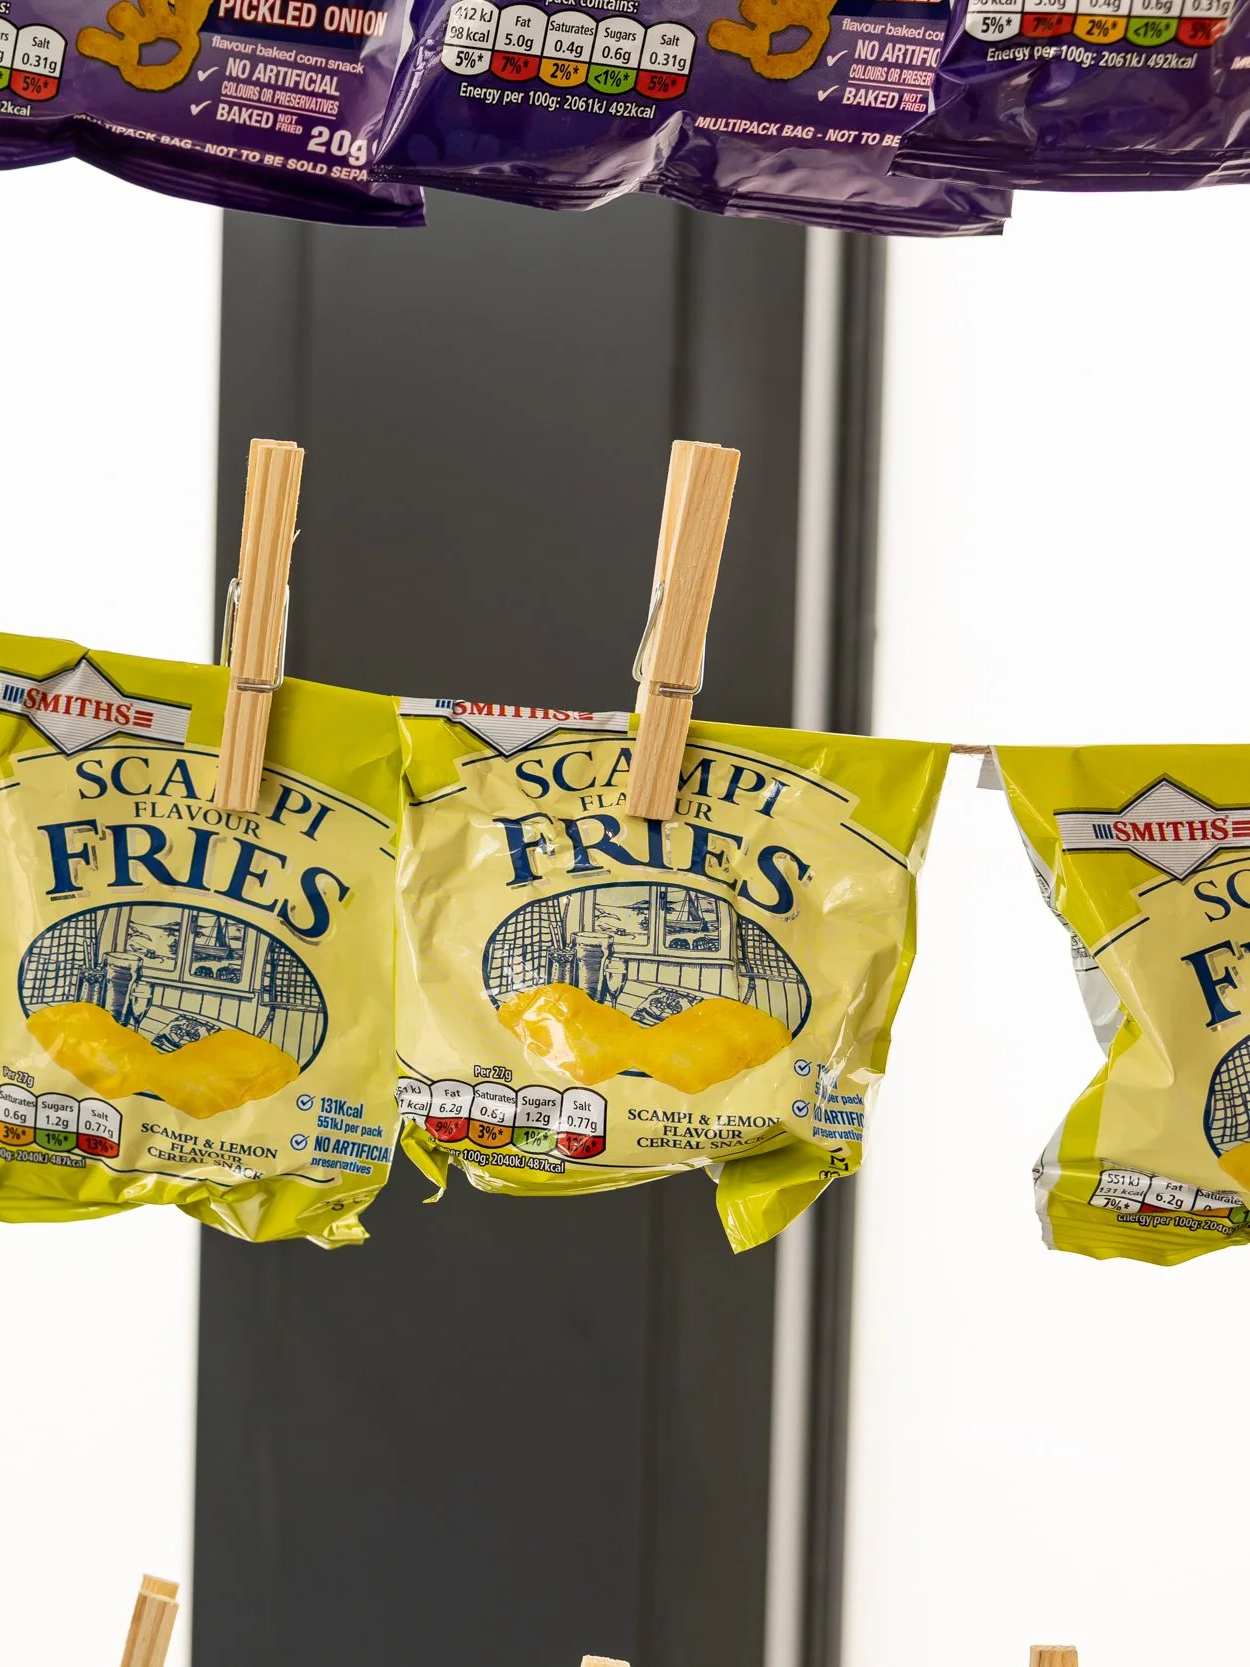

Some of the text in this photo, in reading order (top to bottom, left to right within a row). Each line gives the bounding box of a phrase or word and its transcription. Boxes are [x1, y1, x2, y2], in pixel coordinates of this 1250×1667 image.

[480, 9, 494, 23] kJ
[586, 0, 639, 14] contains:
[218, 0, 388, 37] PICKLED ONION
[515, 15, 531, 28] Fat
[450, 25, 491, 44] 98 kcal
[550, 20, 595, 37] Saturates
[604, 27, 637, 43] Sugars
[842, 19, 924, 39] flavour baked
[32, 36, 50, 50] Salt
[504, 33, 534, 51] 5.0g
[554, 39, 584, 58] 0.4g
[661, 34, 680, 47] Salt
[211, 35, 365, 75] flavour baked corn snack
[602, 46, 632, 64] 0.6g
[855, 39, 879, 61] NO
[987, 45, 1198, 70] Energy 100g: 2061kJ 492kcal
[21, 52, 58, 74] 0.31g
[649, 51, 687, 70] 0.31g
[225, 57, 340, 96] NO ARTIFICIAL
[849, 64, 900, 83] COLOURS OR
[221, 81, 339, 115] COLOURS OR PRESERVATIVES
[459, 82, 656, 120] Energy per 100g: 2061kJ 492kcal
[842, 88, 899, 110] BAKED
[903, 92, 924, 103] NOT
[216, 103, 274, 129] BAKED
[899, 101, 926, 114] FRIED
[277, 113, 299, 125] NOT
[275, 122, 303, 135] FRIED
[694, 116, 902, 148] MULTIPACK BAG NOT TO BE
[306, 125, 368, 167] 20g
[160, 135, 193, 150] BAG
[205, 143, 237, 159] NOT
[240, 148, 262, 163] TO
[263, 154, 284, 168] BE
[287, 157, 328, 176] SOLD
[23, 687, 131, 727] SMITHS
[76, 756, 336, 842] SCAPI
[580, 792, 714, 823] FLAUR
[134, 801, 263, 840] FLAVOUR
[1112, 817, 1229, 842] SMITHS
[492, 812, 813, 915] FRIES
[37, 819, 351, 940] FRIES
[3, 1066, 35, 1088] Per 27g
[474, 1066, 513, 1081] Per 27g
[0, 1090, 36, 1108] Saturates
[444, 1088, 461, 1098] Fat
[475, 1090, 516, 1105] Saturates
[41, 1101, 74, 1113] Sugars
[321, 1096, 364, 1119] 131Kcal
[439, 1103, 463, 1116] 6.2g
[522, 1096, 557, 1109] Sugars
[573, 1100, 592, 1112] Salt
[3, 1107, 28, 1124] 0.6g
[46, 1116, 70, 1130] 1.2g
[91, 1109, 109, 1122] Salt
[480, 1106, 505, 1123] 0.6g
[525, 1112, 551, 1126] 1.2g
[627, 1108, 781, 1128] SCAMPI & LEMON
[84, 1120, 114, 1138] 0.77g
[317, 1115, 383, 1138] 551kJ per pack
[567, 1115, 598, 1133] 0.77g
[662, 1126, 744, 1140] FLAVOUR
[141, 1122, 278, 1160] SCAMPI & LEMON
[314, 1135, 332, 1153] NO
[636, 1134, 767, 1150] CEREAL SNACK
[16, 1150, 86, 1168] 2040kJ 487kcal
[170, 1142, 243, 1165] FLAVOUR
[462, 1149, 566, 1174] 100g: 2040kJ 487kcal
[147, 1146, 264, 1181] CEREAL SNACK
[310, 1157, 372, 1175] preservatives
[1107, 1173, 1141, 1187] 551 kJ
[1165, 1182, 1183, 1192] Fat
[1120, 1188, 1144, 1197] kcal
[1155, 1192, 1184, 1210] 6.2g
[1153, 1216, 1201, 1230] per 100g:
